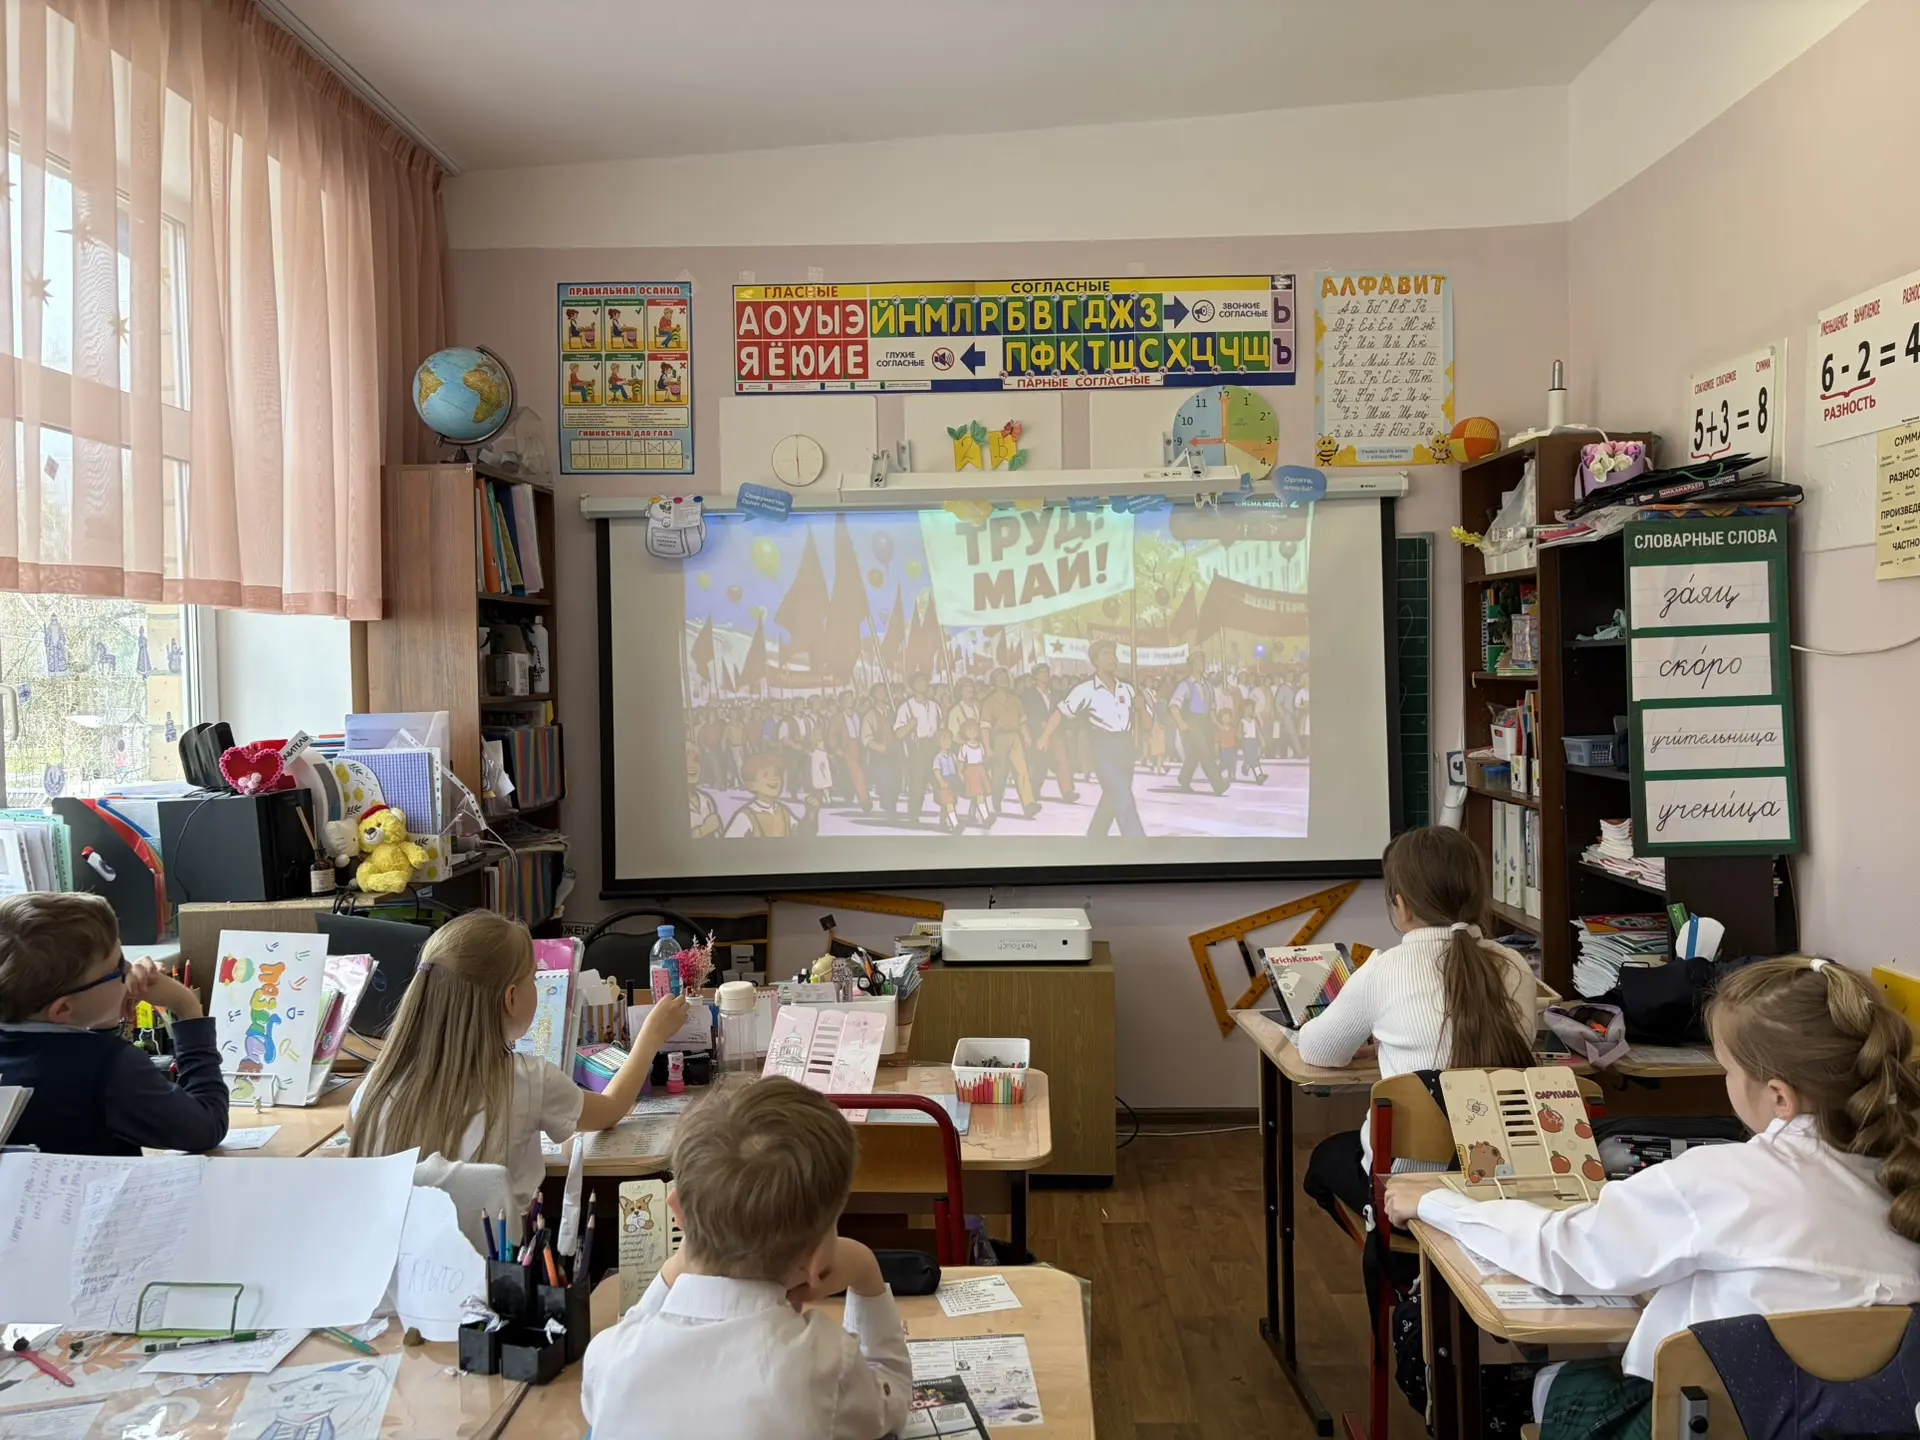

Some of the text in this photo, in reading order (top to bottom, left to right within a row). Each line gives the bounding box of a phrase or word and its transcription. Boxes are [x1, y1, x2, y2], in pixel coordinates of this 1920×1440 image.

[1011, 280, 1110, 294] СОГЛАСНЫЕ
[1322, 273, 1447, 298] АЛФАВИТ
[569, 286, 680, 296] ПРАВИЛЬНАЯ ОСАНКА
[764, 286, 838, 299] ГЛАСНЫЕ
[1222, 302, 1261, 310] ЗВОНКИЕ
[1219, 310, 1268, 318] СОГЛАСНЫЕ
[885, 351, 916, 359] ГЛУХИЕ
[876, 359, 925, 368] СОГЛАСНЫЕ
[1857, 340, 1871, 381] 2
[1017, 374, 1150, 389] ПАРНЫЕ СОГЛАСНЫЕ
[1195, 399, 1207, 408] 11
[1824, 395, 1876, 421] РАЗНОСТЬ
[1260, 412, 1266, 421] 2
[1181, 417, 1193, 426] 10
[634, 430, 651, 438] ДЛЯ
[1176, 438, 1182, 446] 9
[1266, 436, 1272, 444] 3
[961, 436, 976, 461] 2
[1634, 528, 1777, 549] СЛОВАРНЫЕ СЛОВА
[973, 542, 1109, 611] МАЙ!
[1271, 955, 1324, 964] ErichKrause
